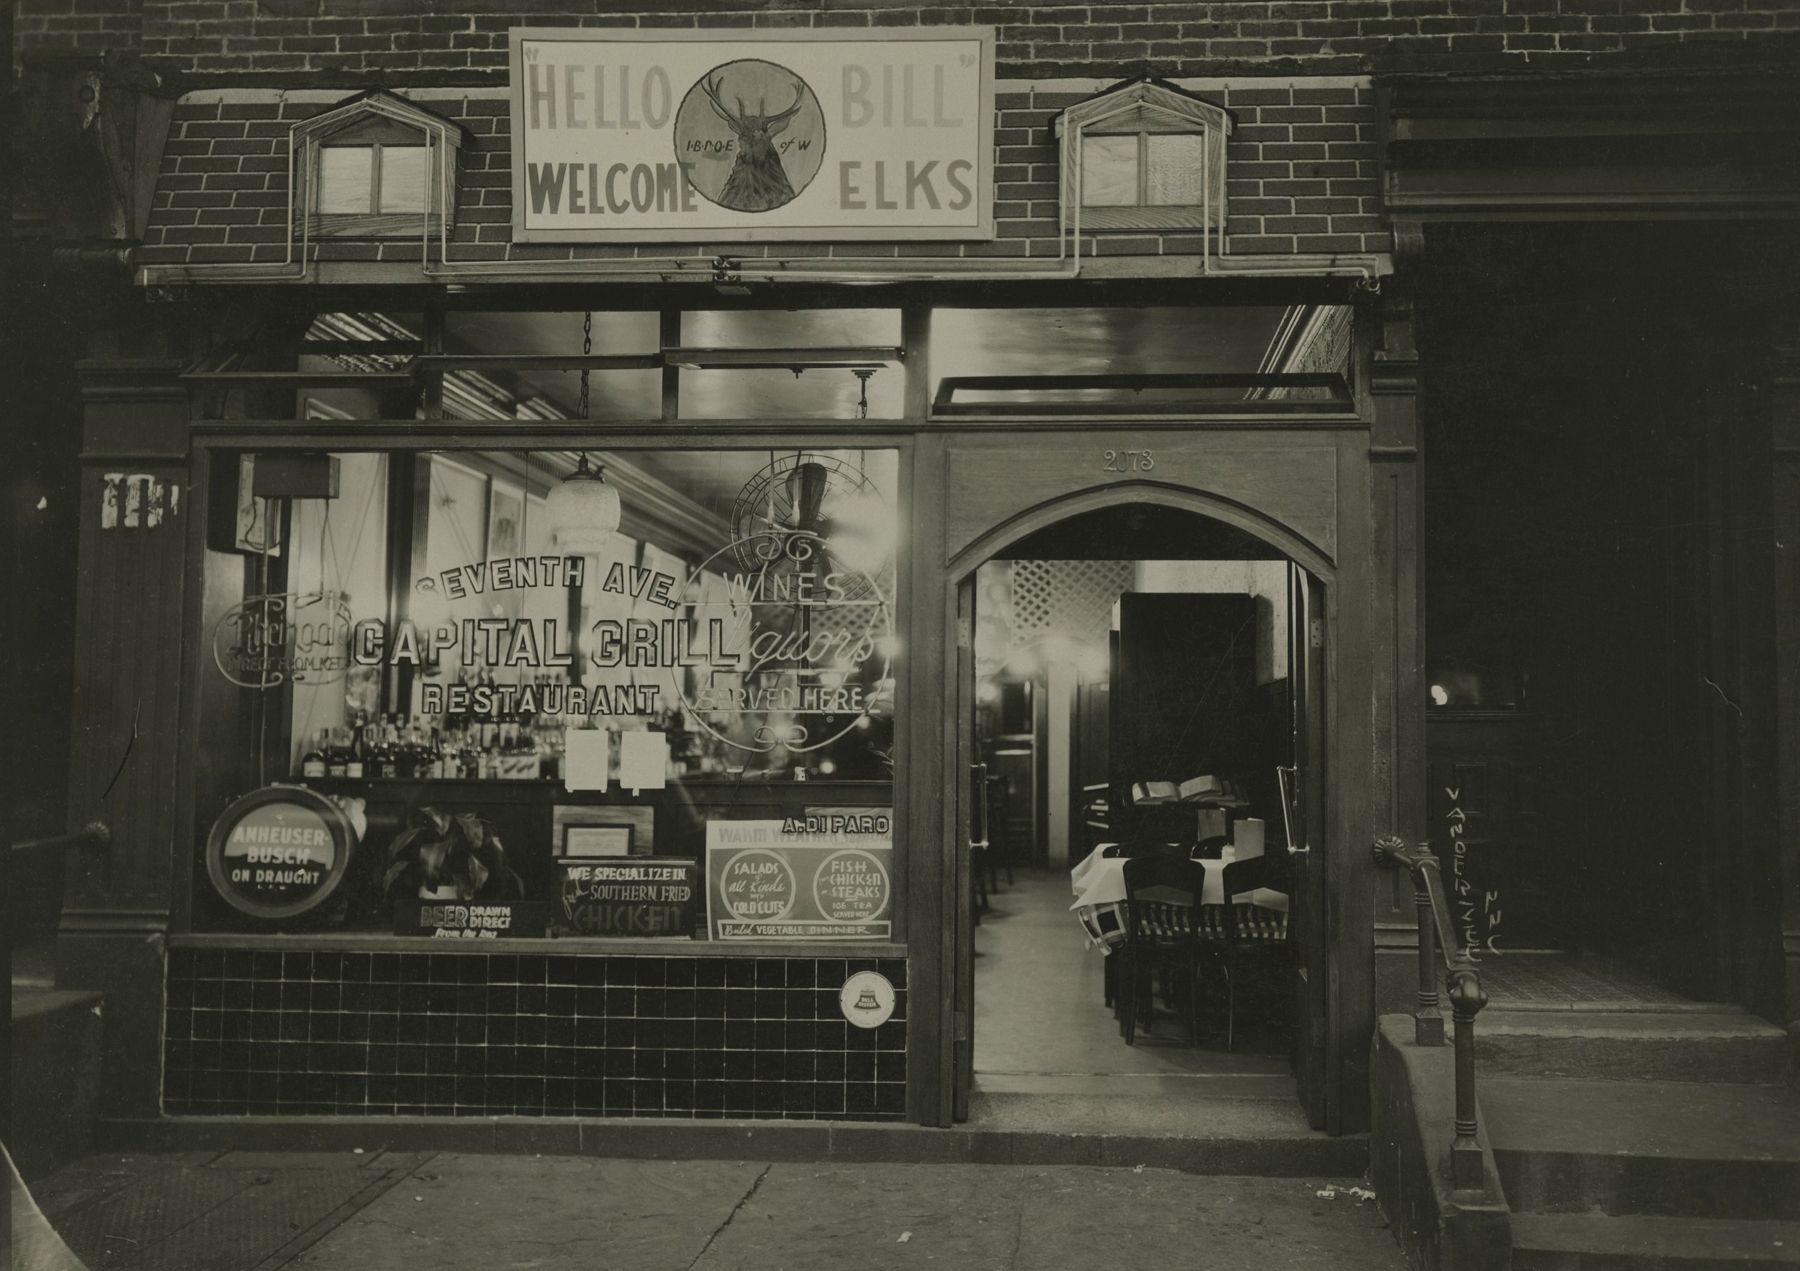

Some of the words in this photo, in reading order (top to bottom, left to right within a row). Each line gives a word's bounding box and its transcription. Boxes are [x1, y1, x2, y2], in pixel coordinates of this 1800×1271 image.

[797, 140, 811, 151] W
[527, 162, 697, 214] WELCOME
[839, 159, 972, 211] ELKS
[1103, 448, 1155, 472] 2073
[602, 562, 679, 610] AVE.
[723, 572, 845, 602] WINES
[353, 618, 573, 667] CAPITAL
[591, 618, 740, 668] GRILL
[421, 684, 660, 715] RESTAURANT
[804, 686, 863, 710] HERE
[830, 815, 890, 834] PARO
[247, 846, 312, 865] BUSCH
[567, 866, 591, 881] WE
[594, 867, 673, 881] SPECIALIZE
[672, 867, 687, 881] IN
[734, 861, 780, 875] SALADS
[831, 860, 867, 873] FISH
[232, 869, 251, 882] ON
[255, 869, 320, 885] DRAUGHT
[829, 872, 881, 886] CHICKEN
[590, 885, 658, 901] SOUTHERN
[660, 885, 692, 902] FRIED
[831, 886, 880, 898] STEAKS
[733, 901, 757, 914] COLD
[757, 901, 785, 914] CUTS
[420, 905, 469, 928] BEER
[469, 905, 511, 917] DRAWN
[469, 917, 512, 929] DIRECT
[755, 925, 803, 935] VEGETABLE
